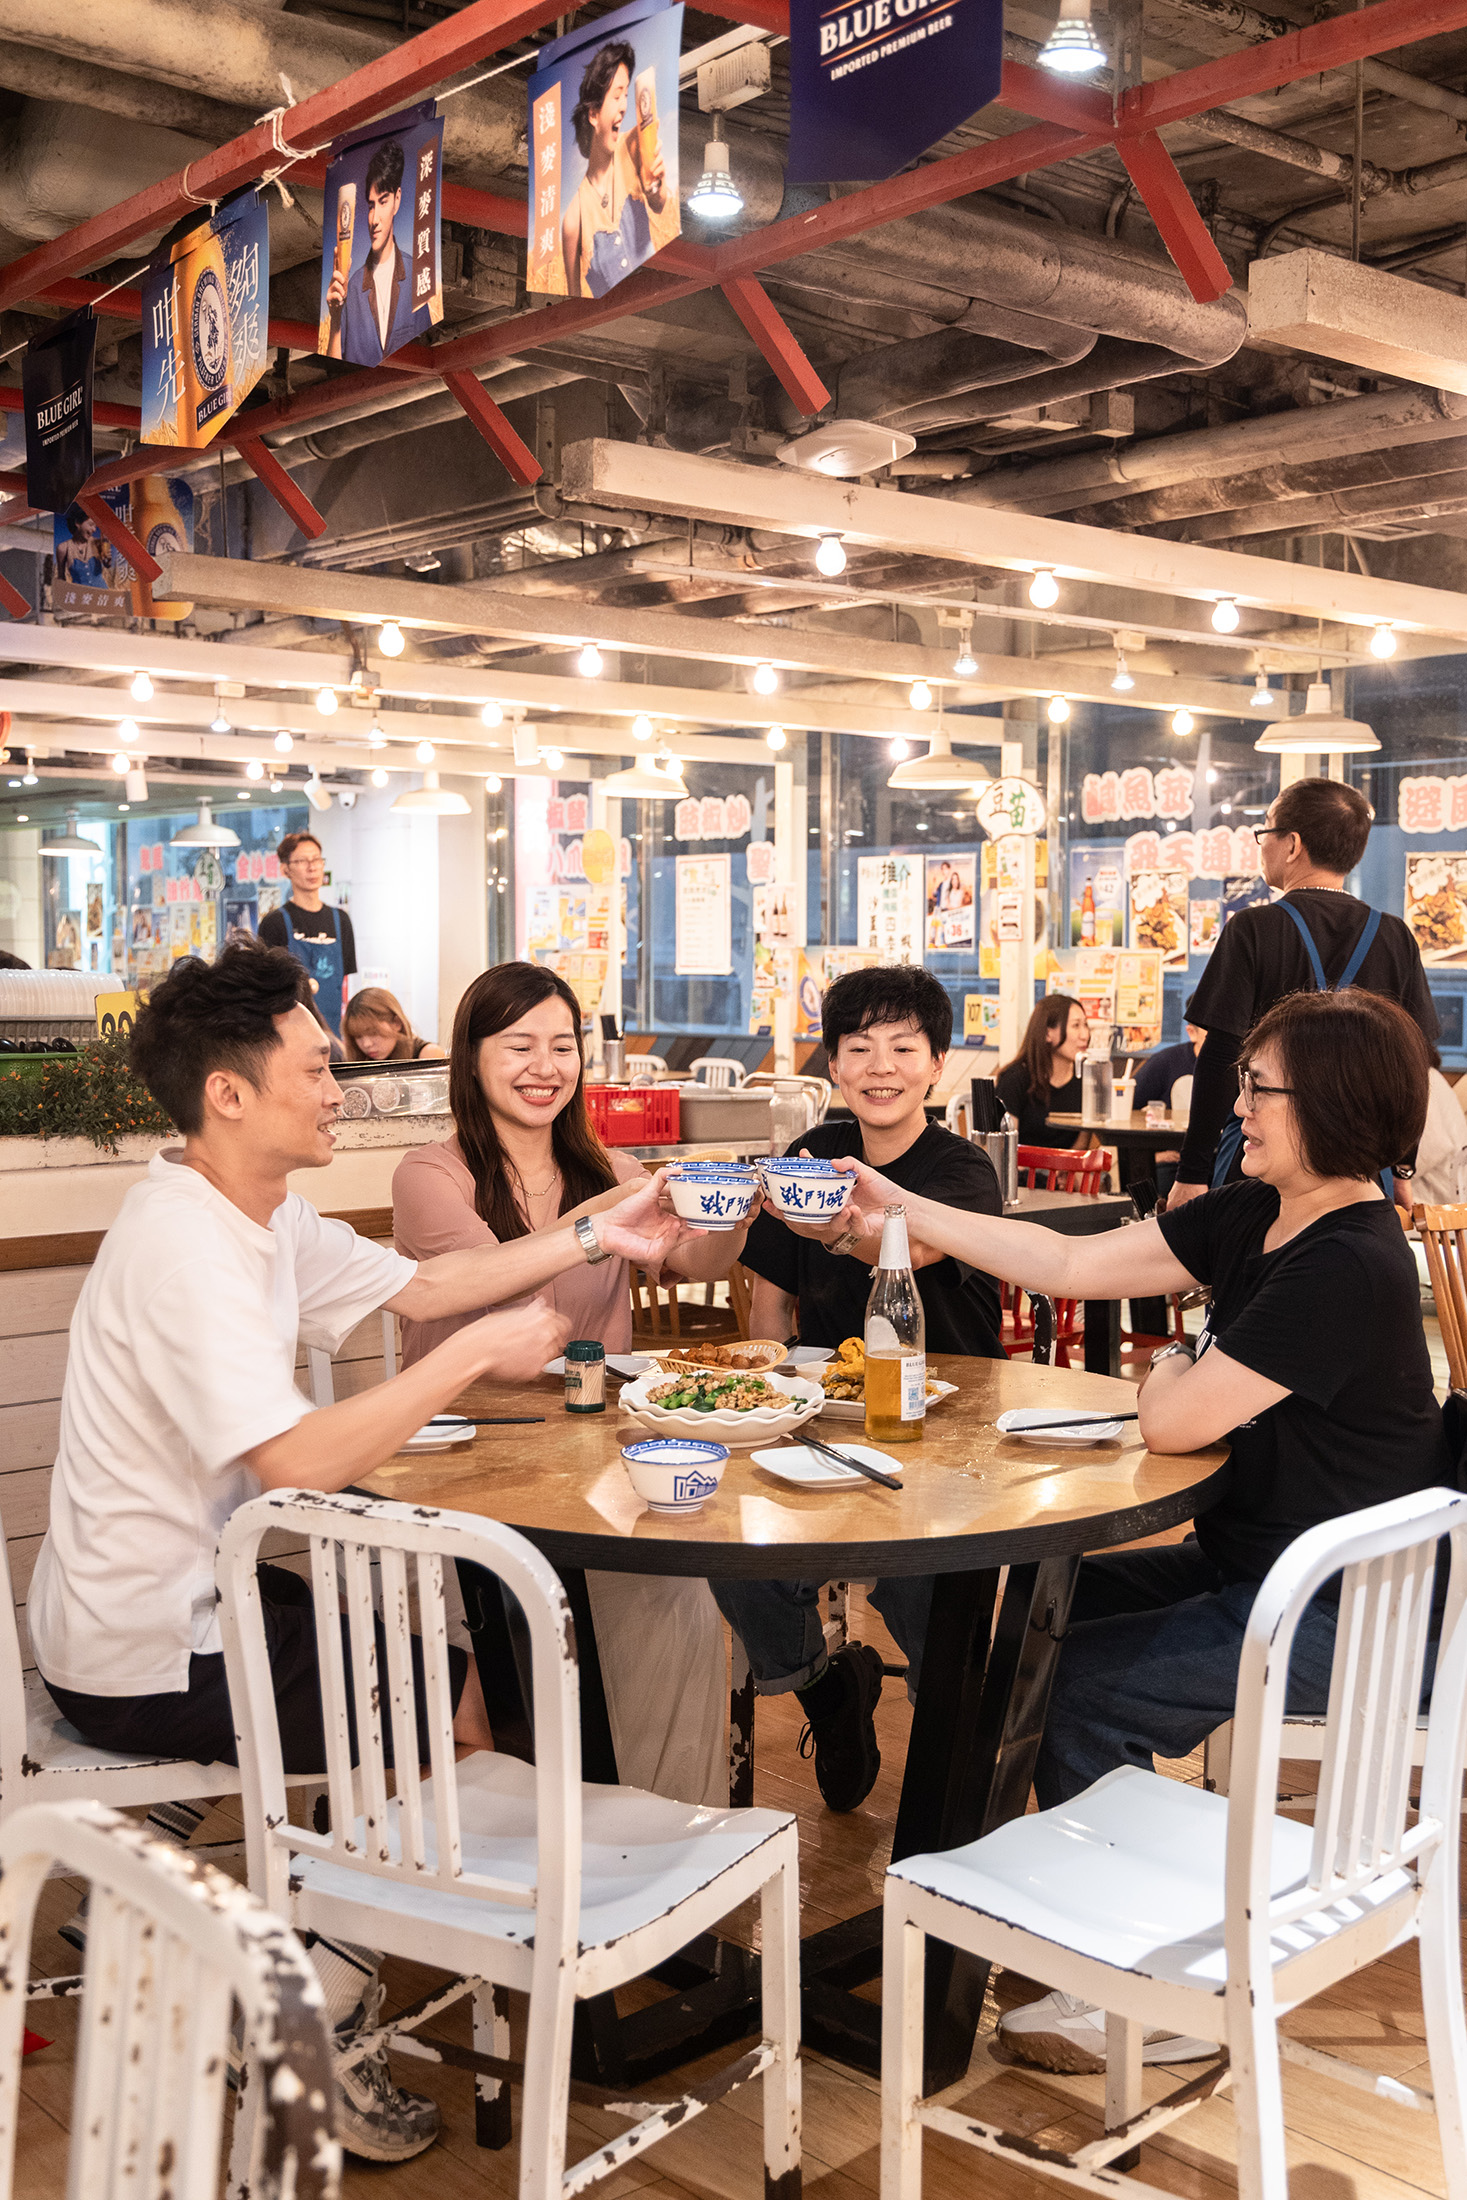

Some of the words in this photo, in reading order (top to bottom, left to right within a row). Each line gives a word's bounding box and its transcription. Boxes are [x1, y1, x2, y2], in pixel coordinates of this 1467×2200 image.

[820, 0, 892, 56] BLUE
[831, 50, 879, 81] IMPORTED
[880, 27, 926, 58] PREMIUM
[927, 14, 952, 36] BEER
[538, 101, 556, 259] 淺麥清爽
[416, 150, 434, 297] 深麥質感
[152, 276, 186, 424] 咁先
[37, 401, 63, 430] BLUE
[63, 386, 83, 415] GIRL
[198, 398, 218, 423] BLUE
[989, 784, 1026, 828] 豆苗
